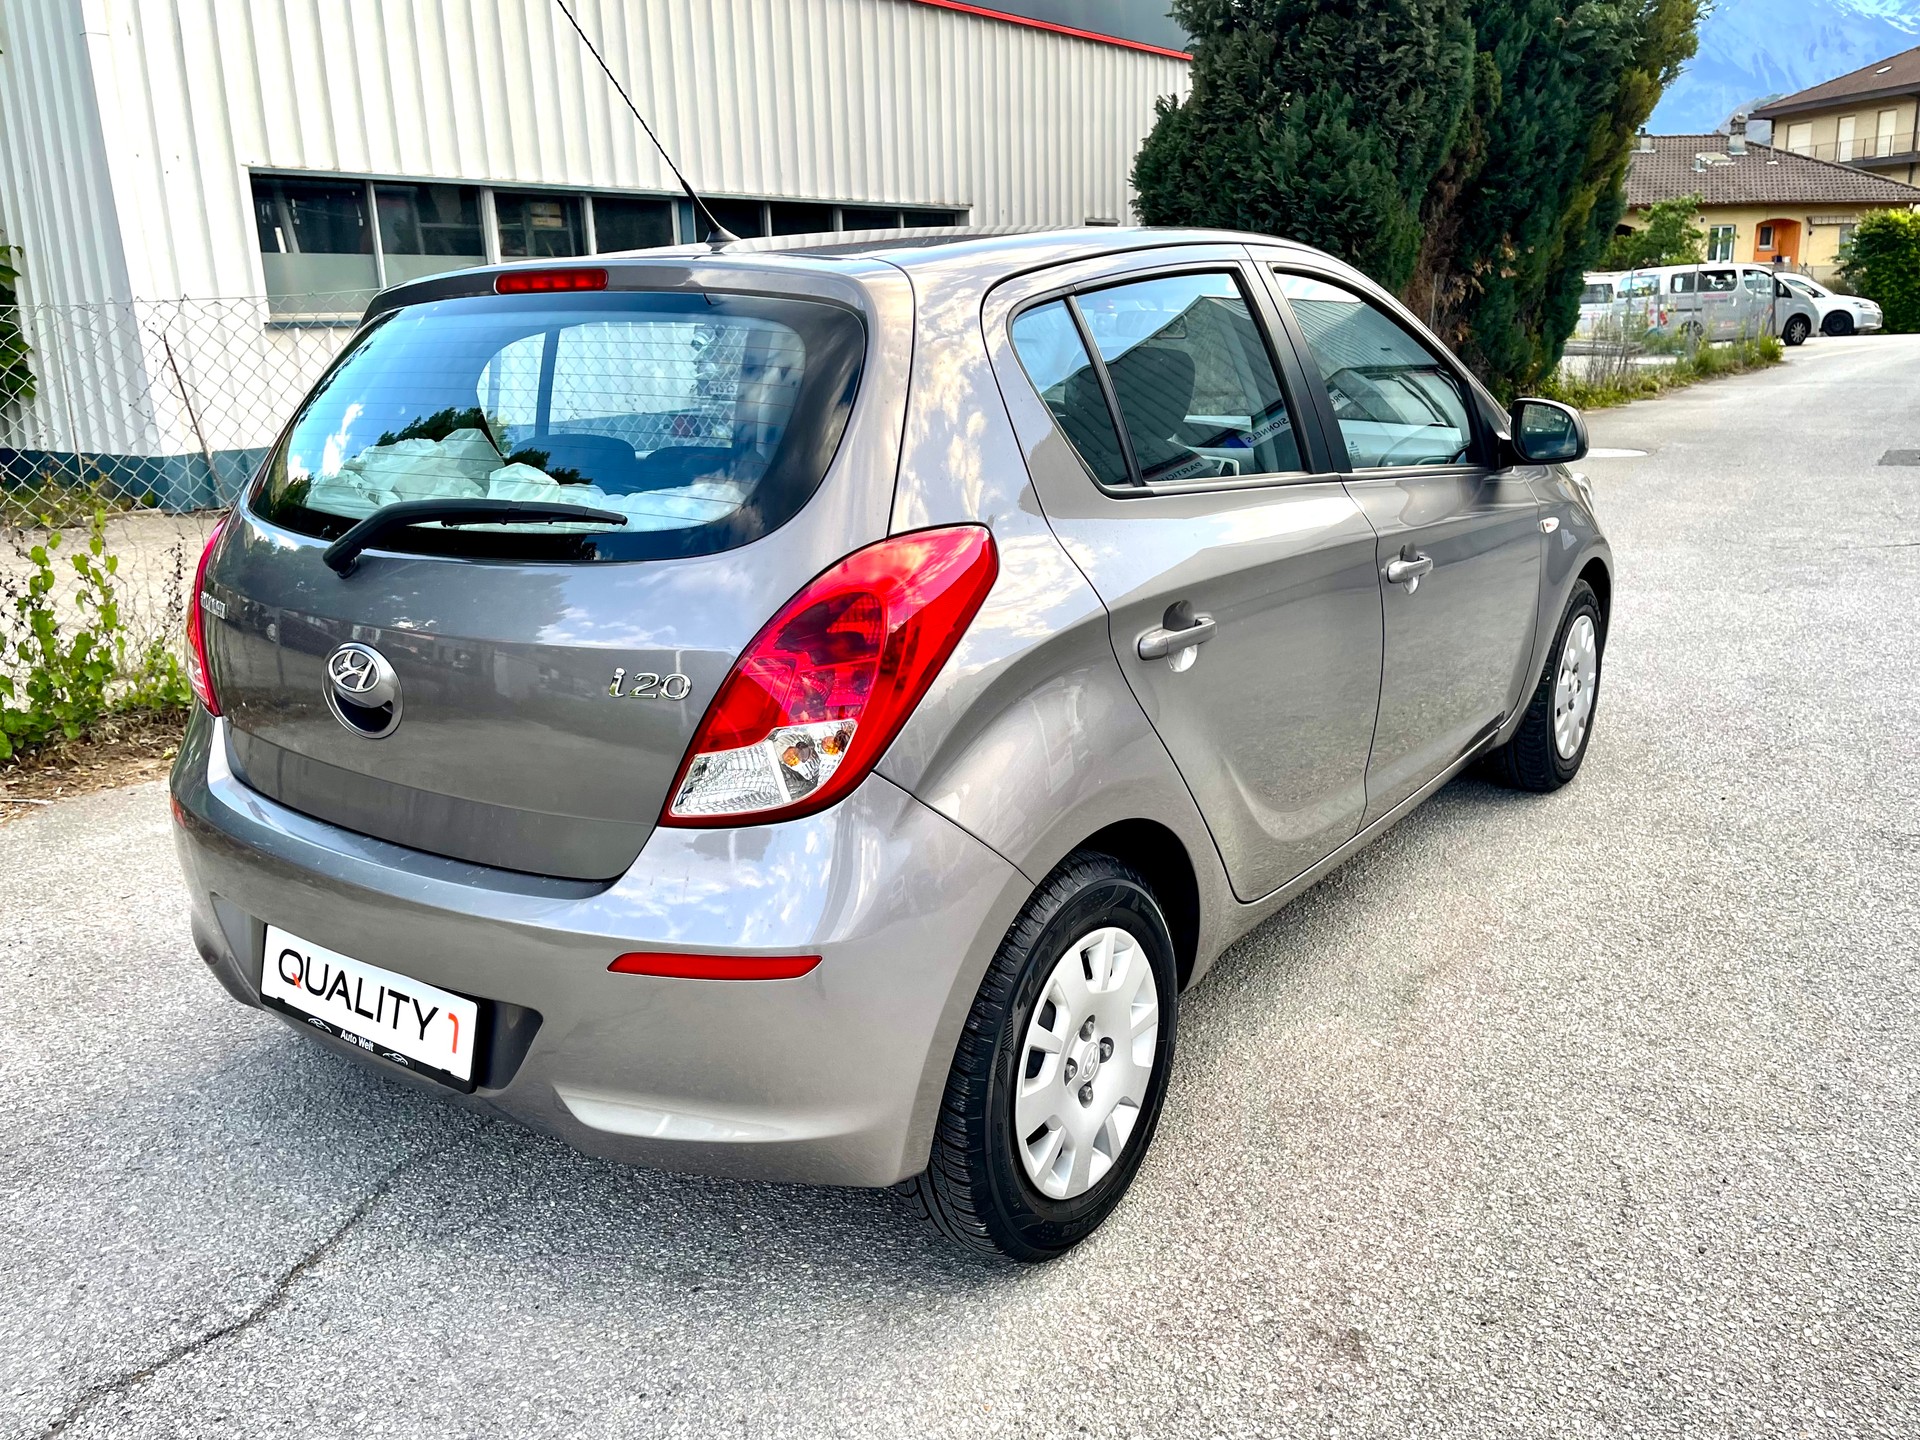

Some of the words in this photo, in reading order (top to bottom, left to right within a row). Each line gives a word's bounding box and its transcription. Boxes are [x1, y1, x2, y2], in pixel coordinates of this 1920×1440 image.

[608, 667, 692, 700] i20
[278, 948, 439, 1041] QUALITY
[448, 1012, 459, 1054] 1
[340, 1029, 357, 1045] Auto
